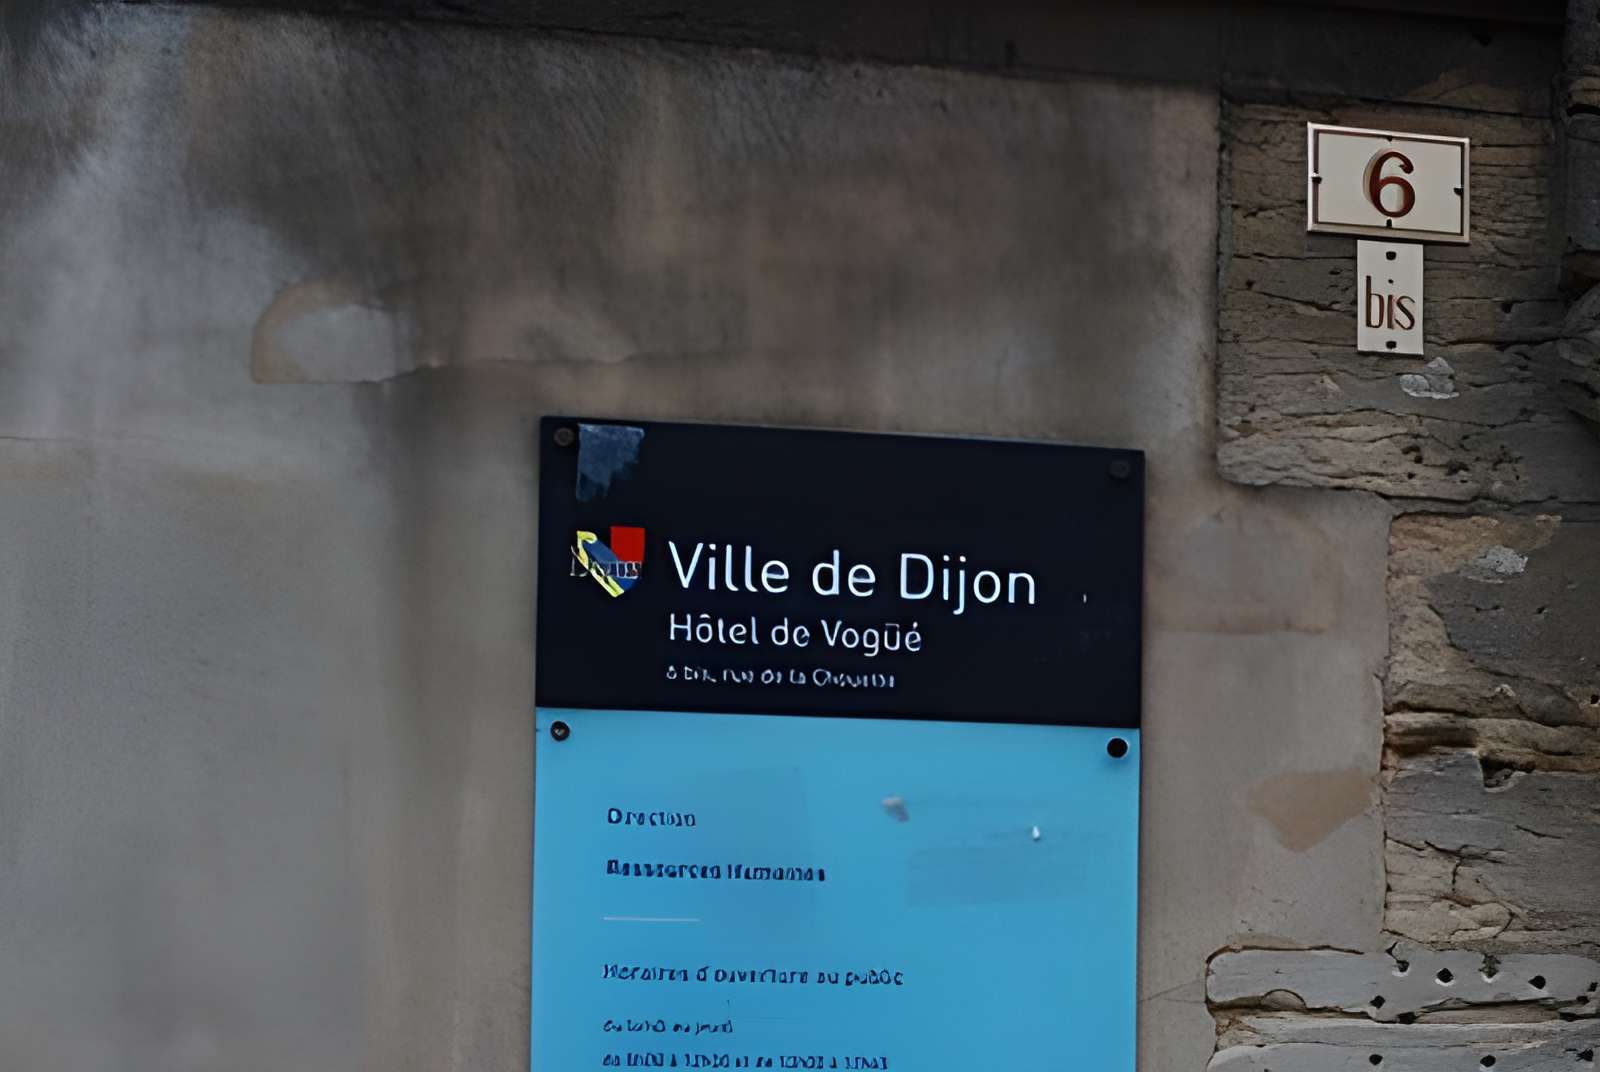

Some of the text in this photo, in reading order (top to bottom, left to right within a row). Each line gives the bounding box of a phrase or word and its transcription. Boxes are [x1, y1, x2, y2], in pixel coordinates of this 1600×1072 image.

[1364, 149, 1415, 218] 6
[1366, 275, 1415, 330] bis
[669, 541, 789, 593] Ville
[812, 549, 876, 597] de
[900, 552, 1035, 615] Dijon
[669, 613, 759, 644] Hôtel
[771, 617, 810, 647] de
